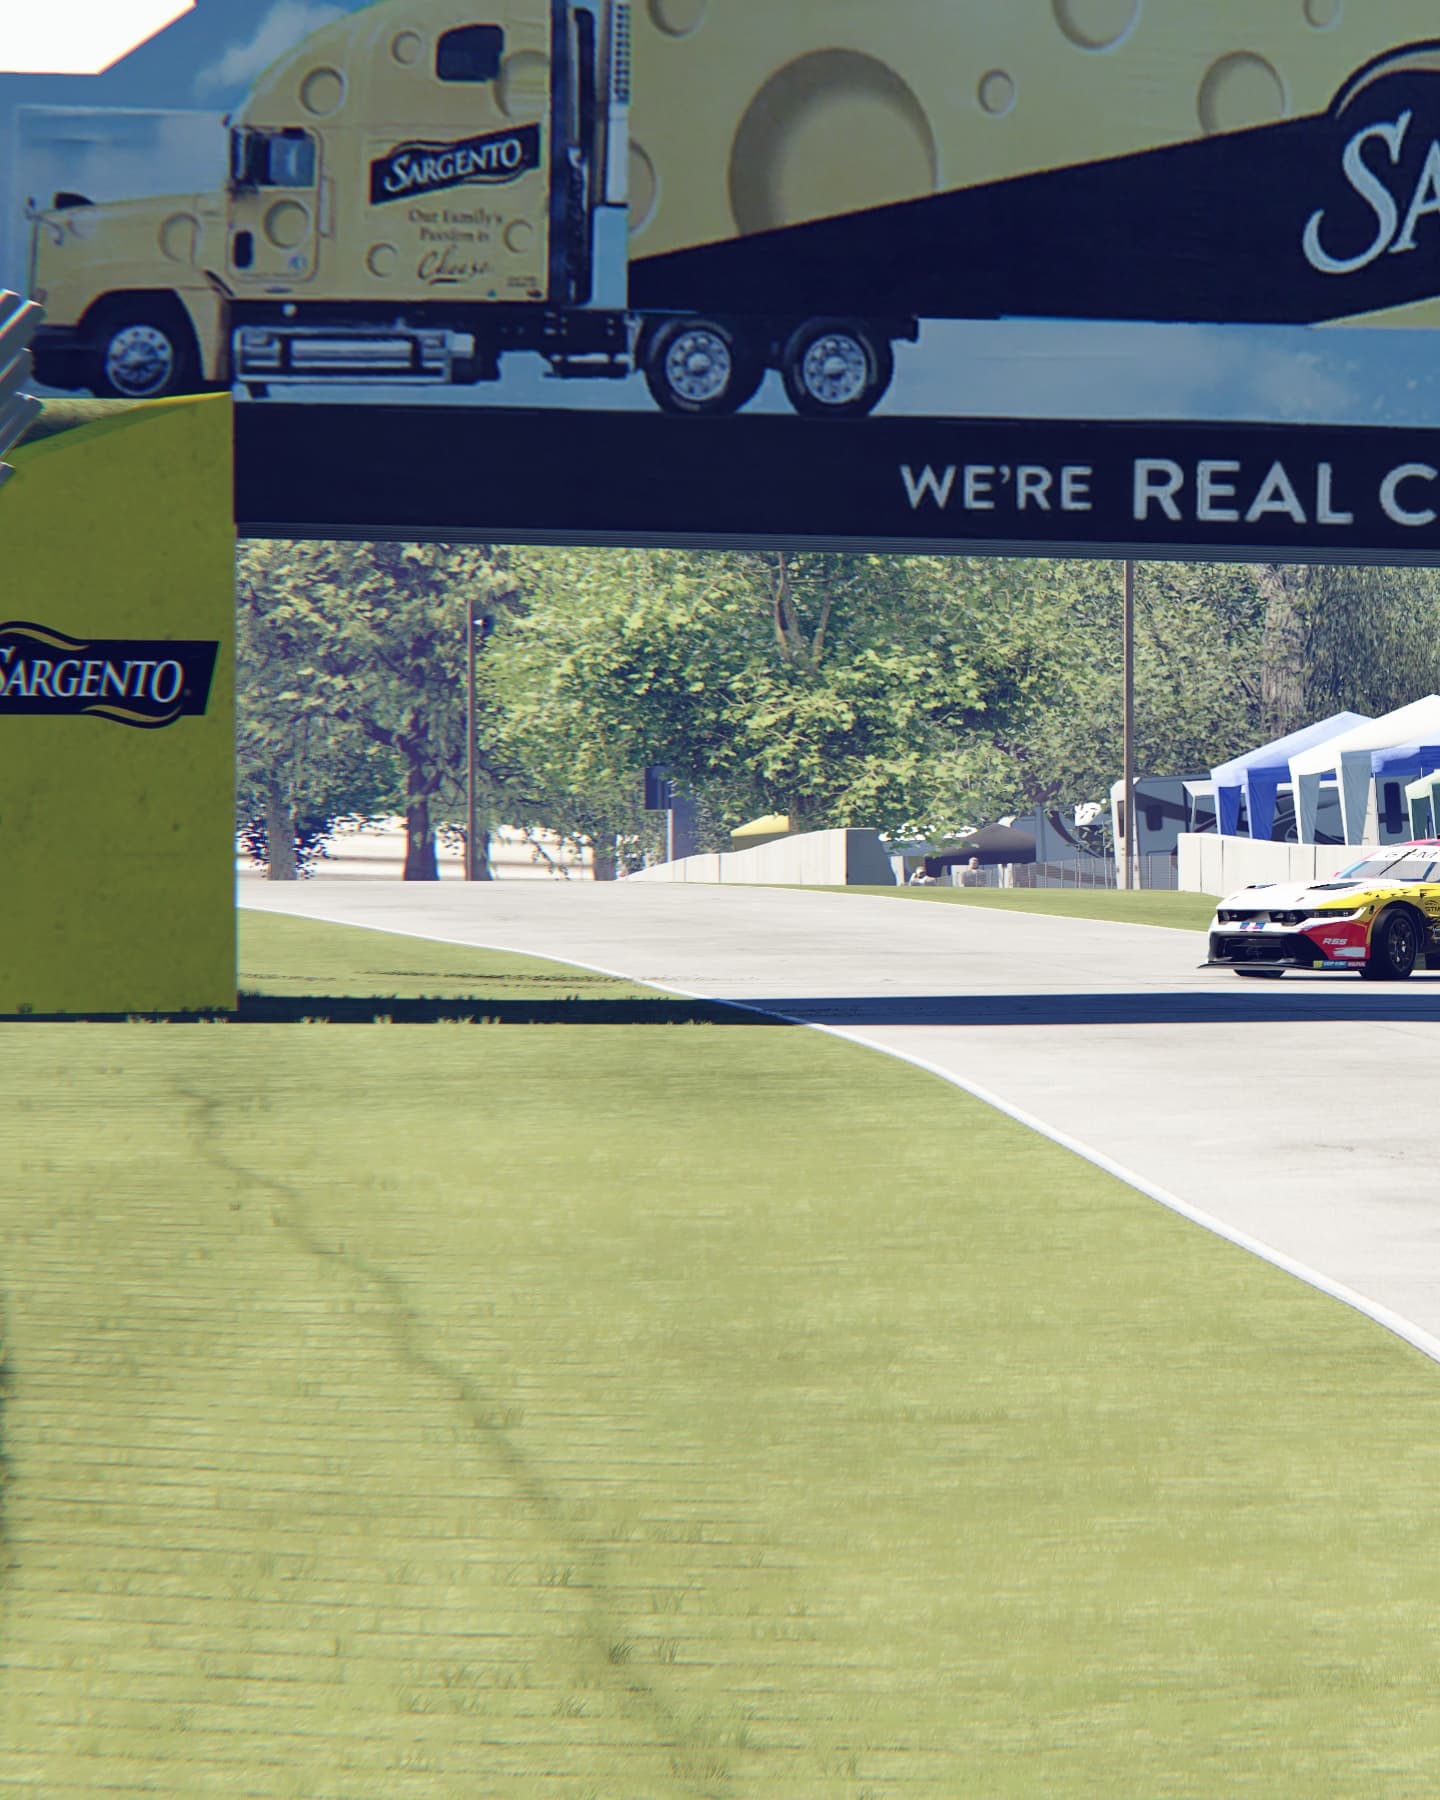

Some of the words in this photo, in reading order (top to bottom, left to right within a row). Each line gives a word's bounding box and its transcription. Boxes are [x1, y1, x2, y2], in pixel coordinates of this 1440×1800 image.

[384, 139, 522, 192] SARGENTO
[900, 464, 1093, 511] WE'RE
[1133, 458, 1353, 524] REAL
[1322, 937, 1348, 945] RSS
